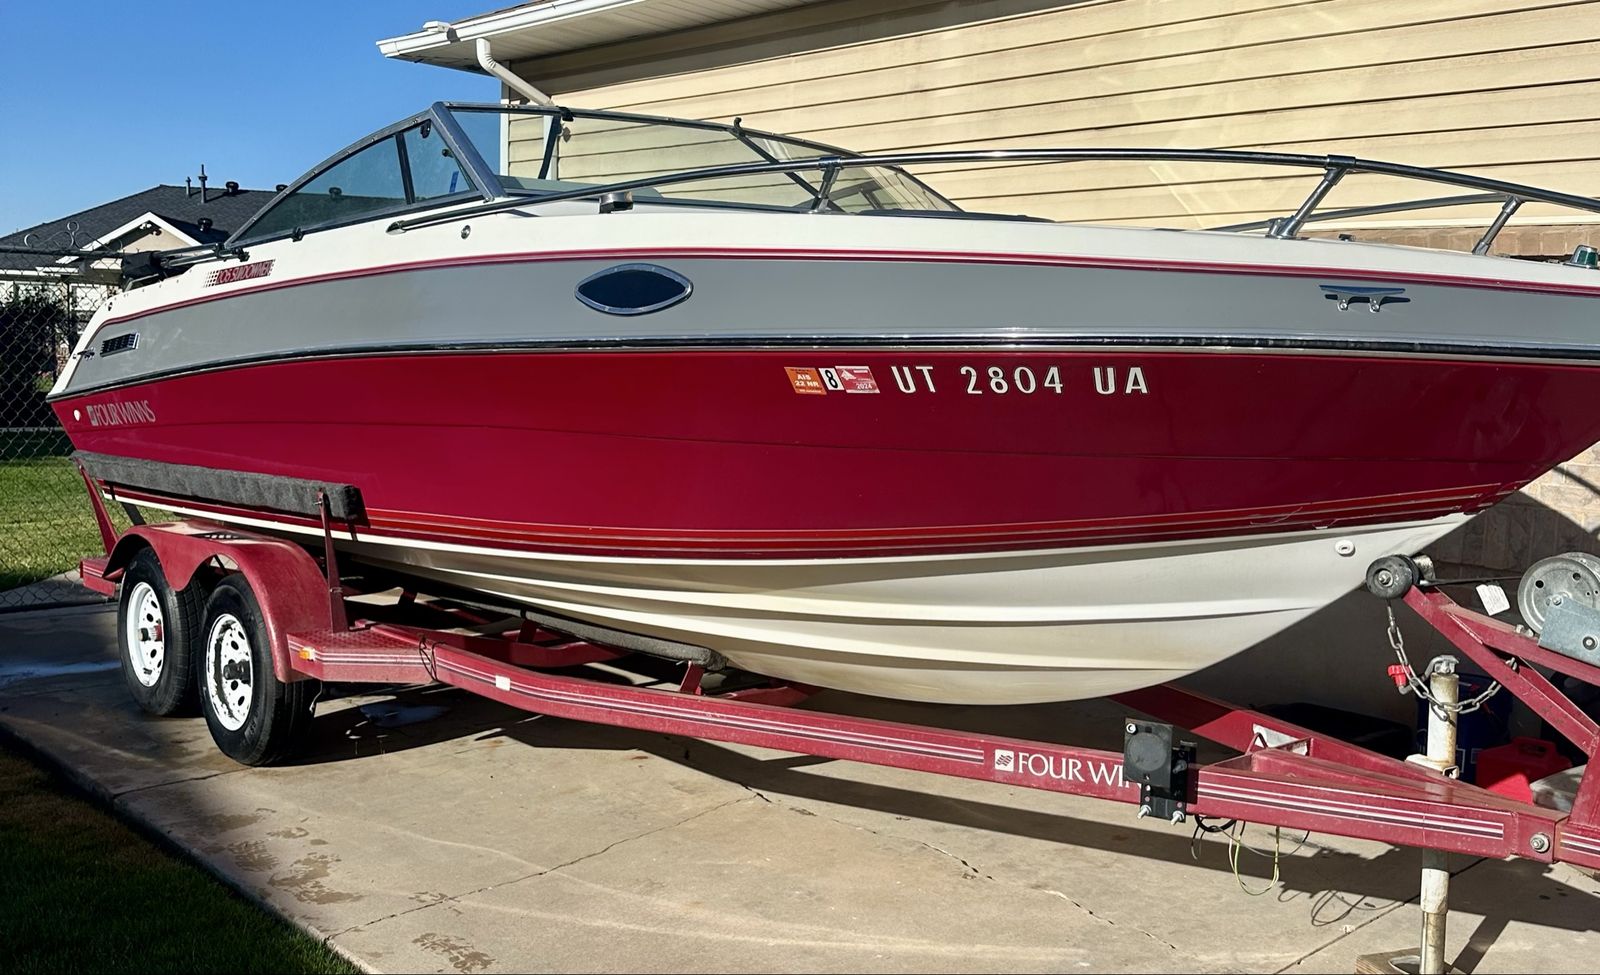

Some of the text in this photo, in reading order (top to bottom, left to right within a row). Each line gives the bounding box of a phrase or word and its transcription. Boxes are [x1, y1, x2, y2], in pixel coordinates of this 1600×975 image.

[796, 373, 812, 381] AIS
[825, 369, 839, 389] 8
[891, 366, 1148, 395] UT 2804 UA
[94, 400, 156, 426] FOUR WINNS
[1018, 752, 1085, 782] FOUR
